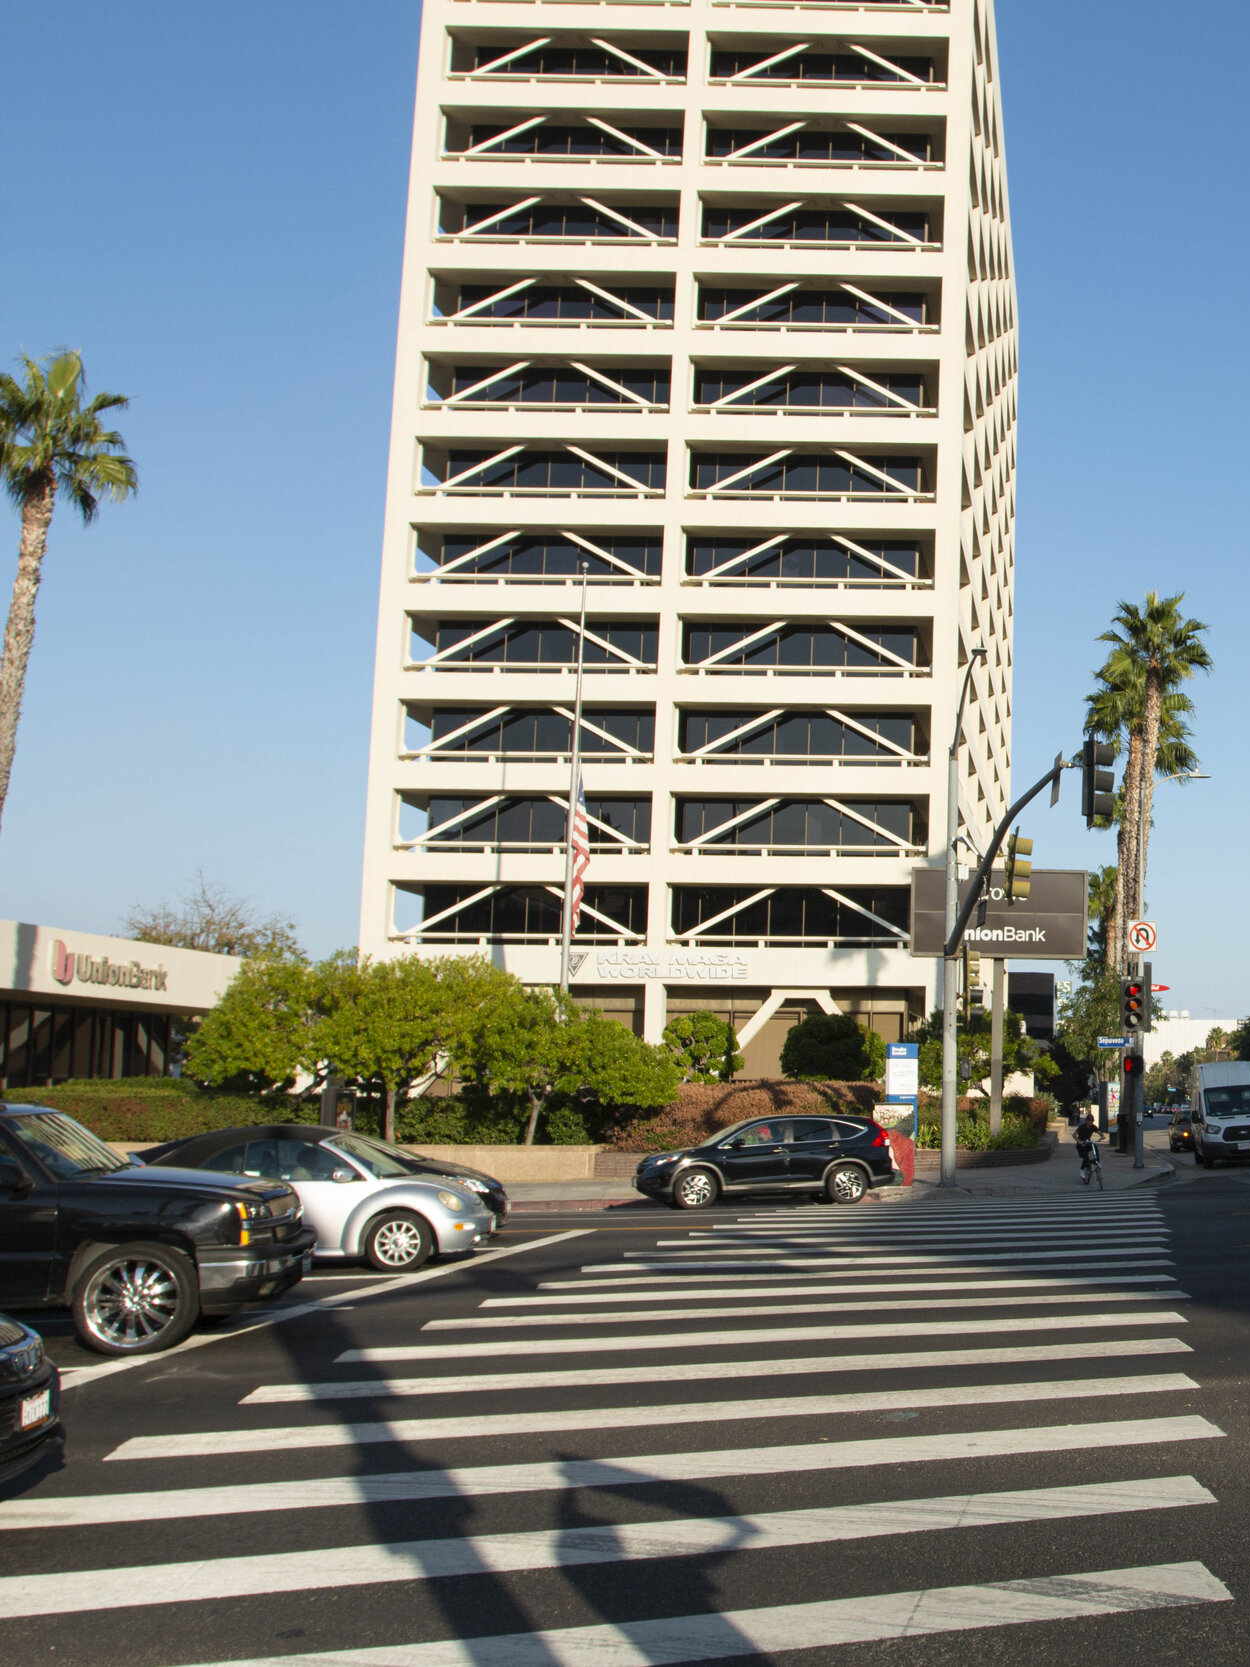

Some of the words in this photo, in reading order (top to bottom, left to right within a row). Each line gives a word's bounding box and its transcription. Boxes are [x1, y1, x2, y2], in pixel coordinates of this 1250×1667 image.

[963, 927, 1046, 942] nionBank
[597, 952, 660, 966] KRAV
[668, 952, 749, 966] MAGA
[77, 953, 168, 992] UnionBank
[597, 966, 749, 980] WORLDWIDE
